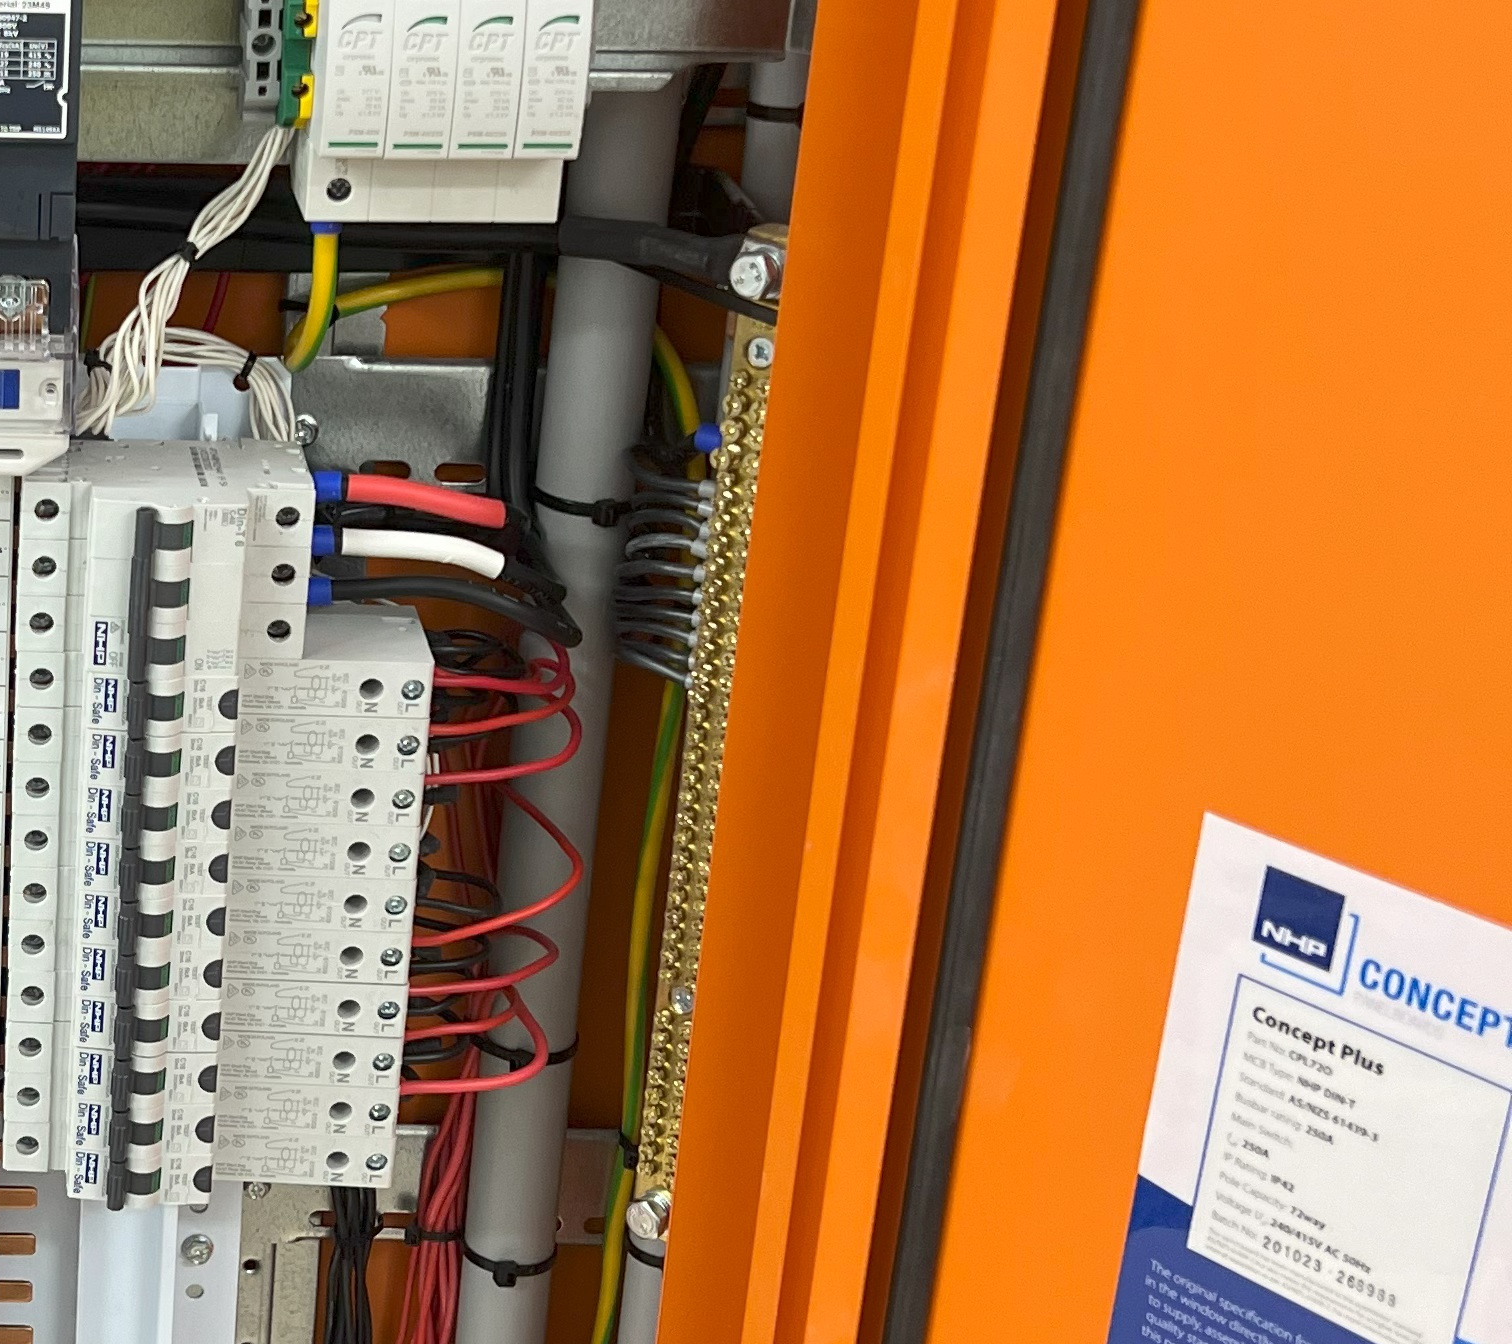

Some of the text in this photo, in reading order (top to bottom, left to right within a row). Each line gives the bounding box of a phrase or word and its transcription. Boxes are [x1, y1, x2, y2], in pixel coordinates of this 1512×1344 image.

[95, 622, 107, 664] NHP
[93, 678, 104, 693] Din
[92, 702, 103, 724] Safe
[1261, 918, 1328, 957] NHP
[1359, 958, 1512, 1048] CONCEPT
[1252, 1006, 1385, 1076] Concept Plus
[1262, 1235, 1322, 1272] 201023
[1151, 1258, 1172, 1280] The
[1173, 1274, 1218, 1302] original
[1219, 1297, 1294, 1343] specification
[1159, 1282, 1178, 1300] the
[1180, 1295, 1228, 1325] window
